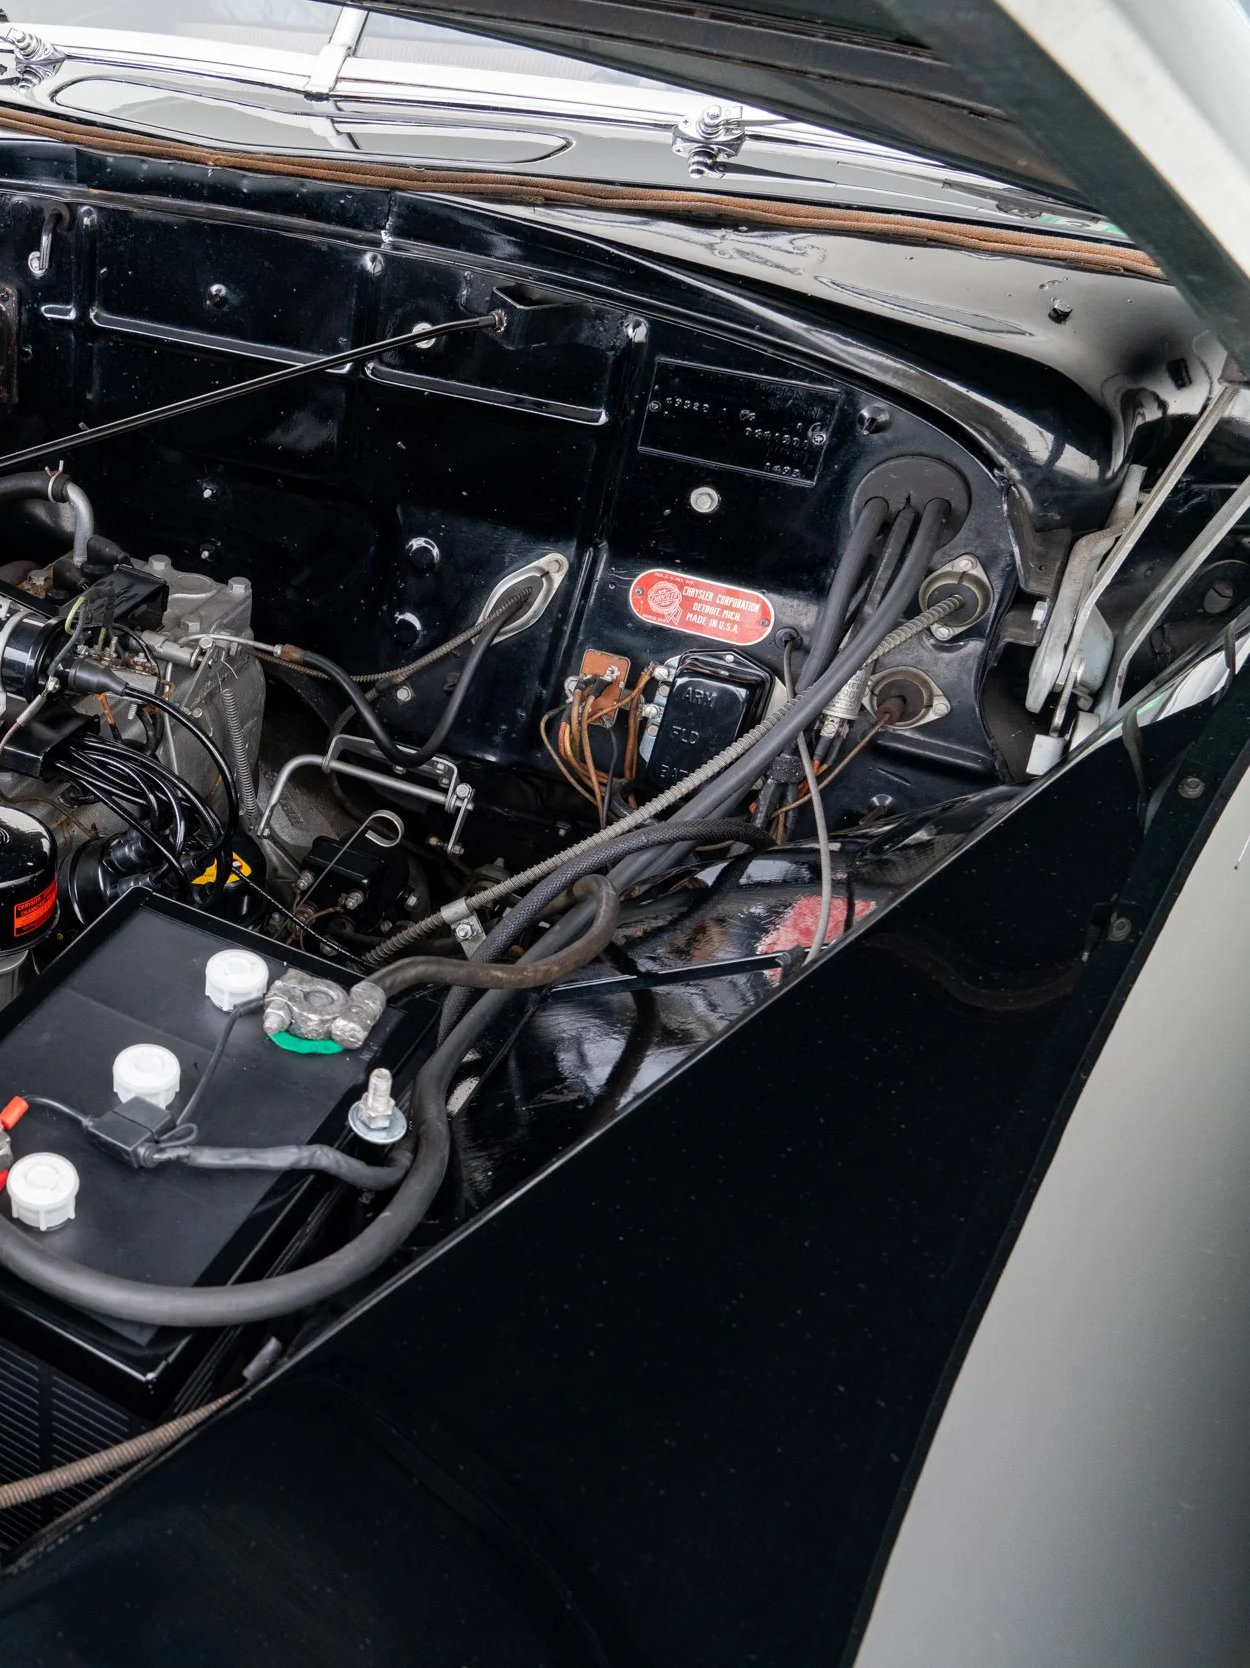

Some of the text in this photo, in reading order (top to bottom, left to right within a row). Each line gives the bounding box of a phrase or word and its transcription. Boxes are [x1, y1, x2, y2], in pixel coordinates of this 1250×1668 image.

[682, 586, 761, 613] CHRYSLER CORPORATION
[686, 613, 706, 625] MADE
[709, 618, 718, 628] IN
[682, 687, 718, 707] ARM
[672, 725, 699, 744] FLD
